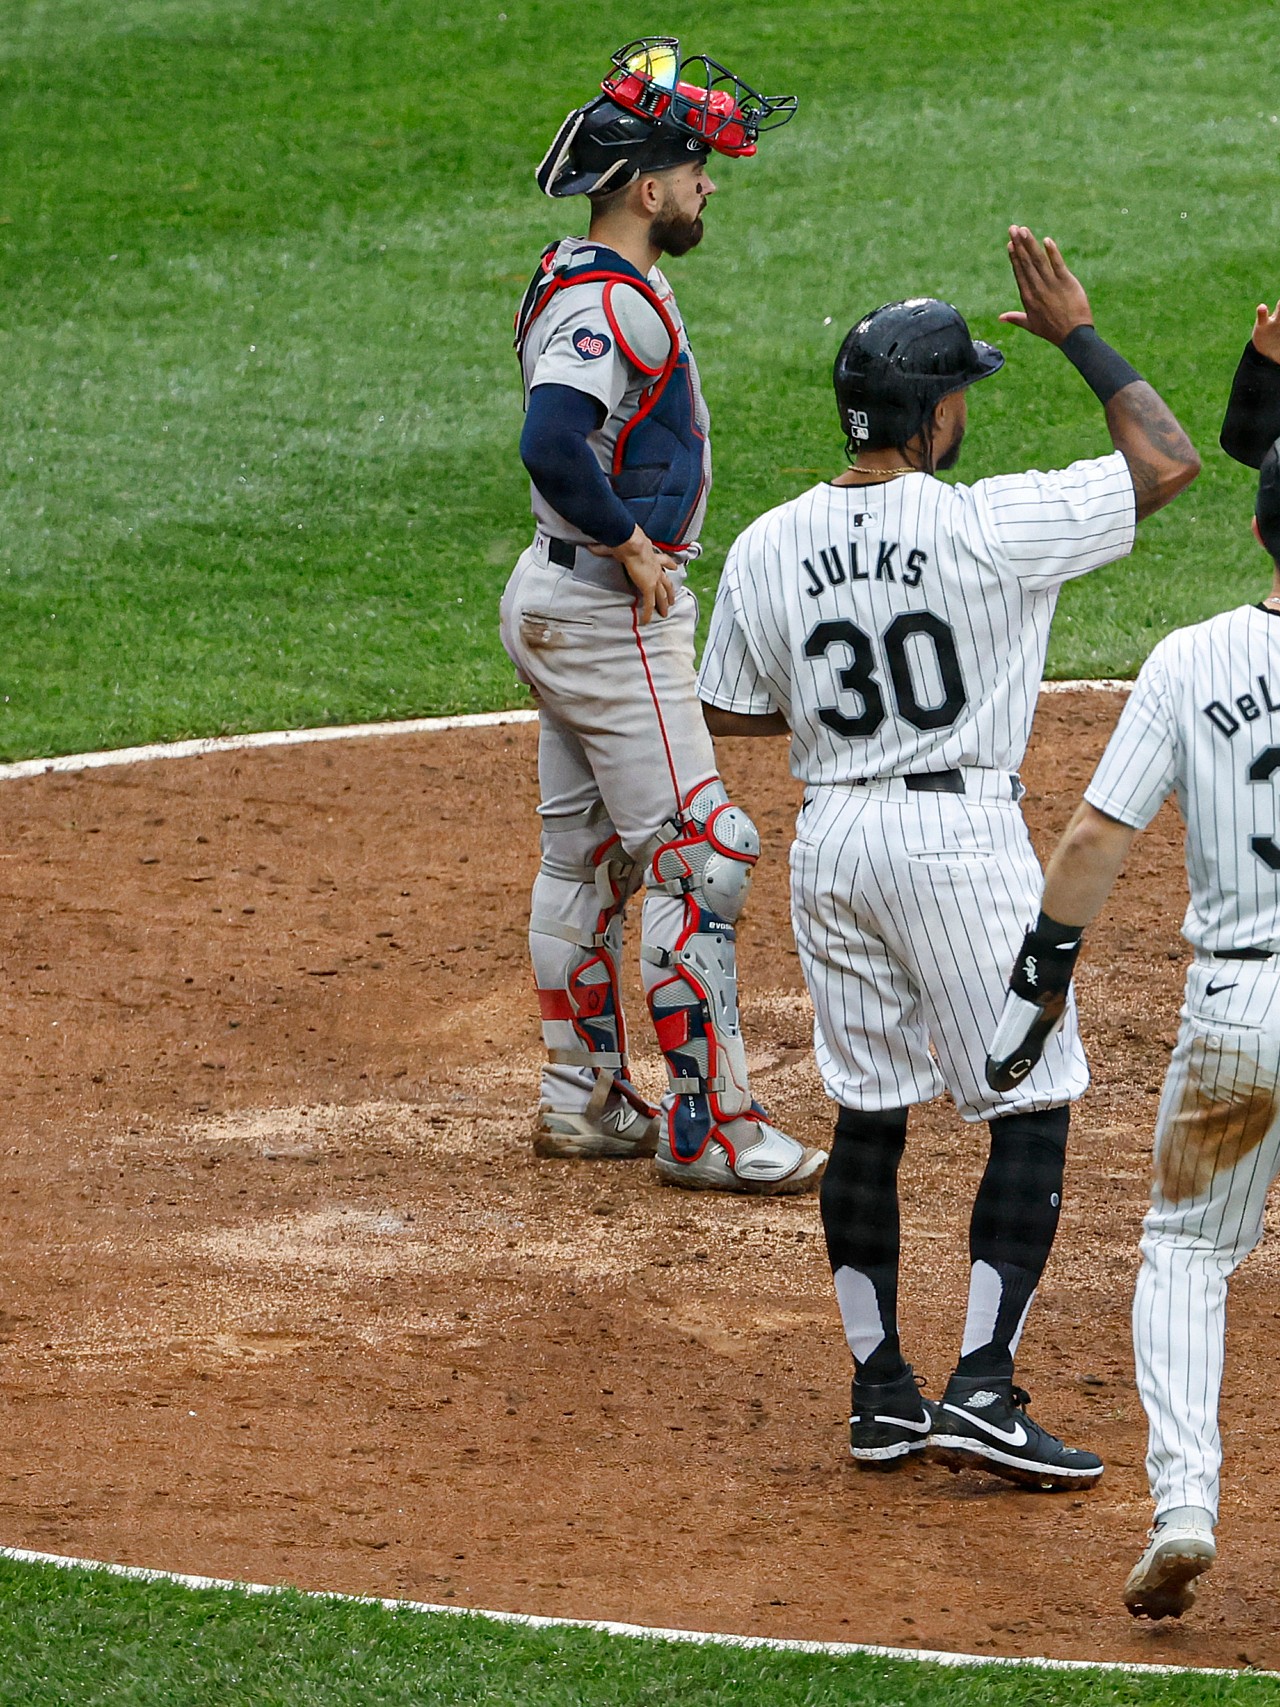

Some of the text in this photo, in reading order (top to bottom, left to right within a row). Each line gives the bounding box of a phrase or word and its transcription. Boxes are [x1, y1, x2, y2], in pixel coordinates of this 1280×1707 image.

[577, 336, 604, 356] 49
[847, 408, 869, 427] 30
[801, 541, 928, 598] JULKS
[801, 608, 970, 740] 30
